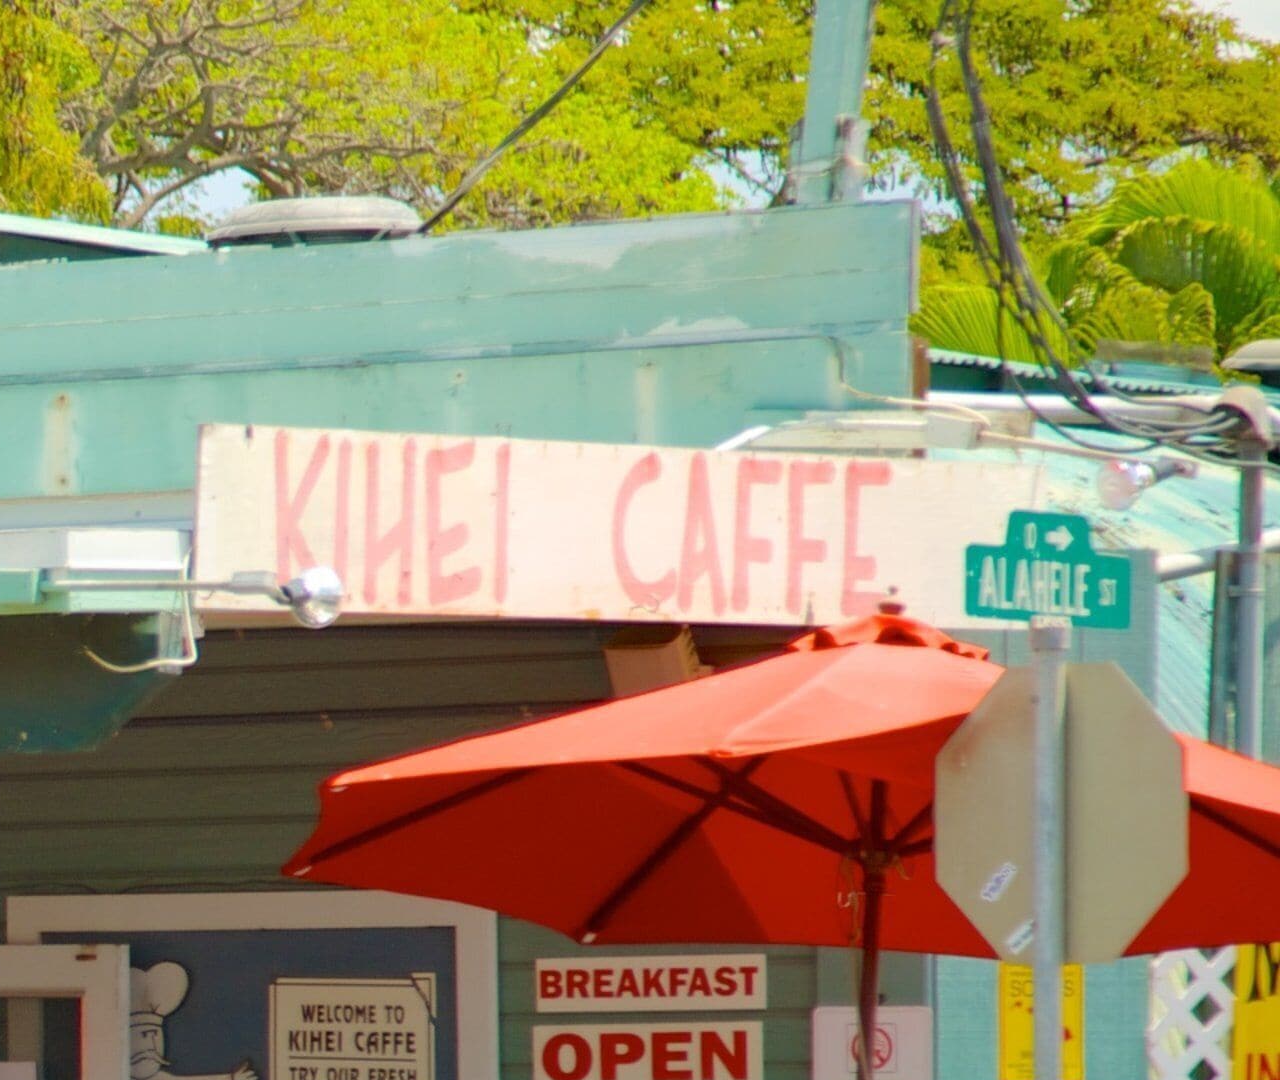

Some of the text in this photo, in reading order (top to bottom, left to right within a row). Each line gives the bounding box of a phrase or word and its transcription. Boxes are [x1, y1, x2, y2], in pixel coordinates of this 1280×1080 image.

[274, 430, 893, 616] KIHEI CAFFE
[978, 555, 1117, 617] ALAHELE ST
[539, 967, 758, 1000] BREAKFAST
[301, 1004, 405, 1025] WELCOME TO
[288, 1031, 417, 1054] KIHEI CAFFE
